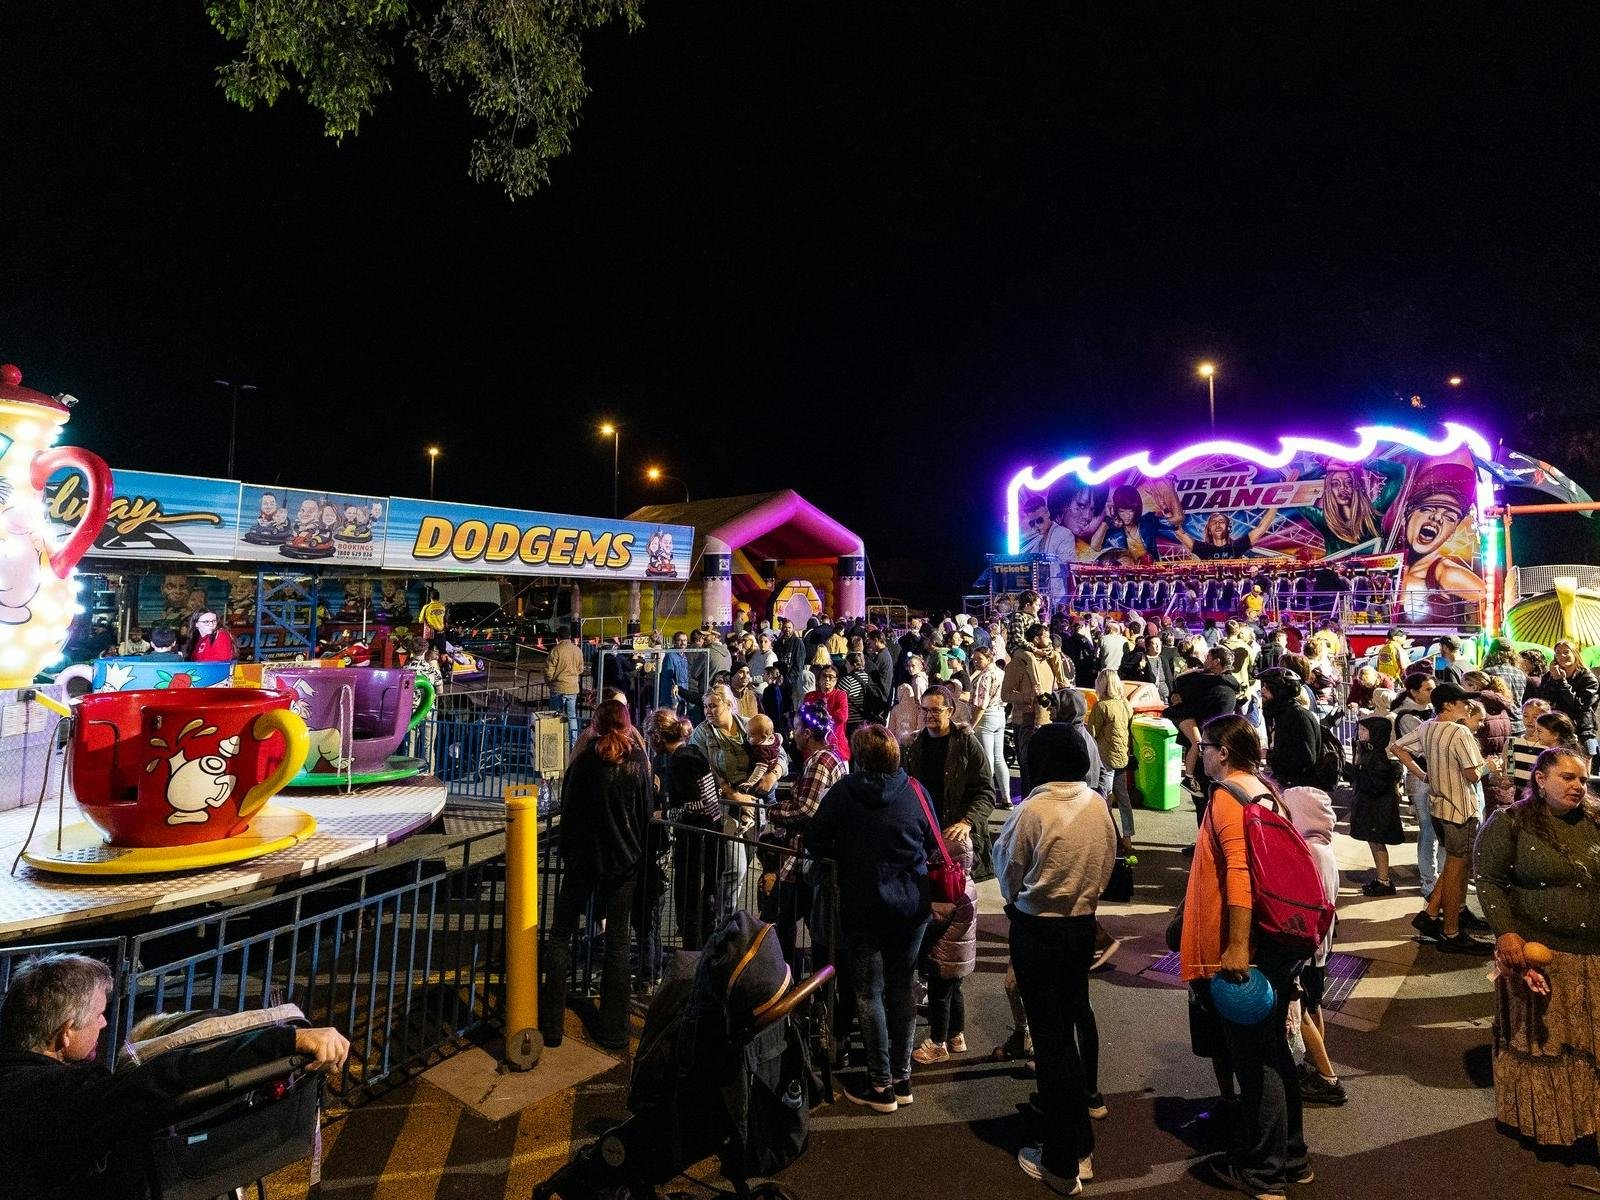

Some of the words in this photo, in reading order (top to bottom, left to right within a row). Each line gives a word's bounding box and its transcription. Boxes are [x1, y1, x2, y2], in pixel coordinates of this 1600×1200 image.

[1177, 474, 1252, 492] DEVIL
[1181, 484, 1321, 510] DANCE
[412, 515, 634, 569] DODGEMS
[993, 565, 1029, 574] Tickets
